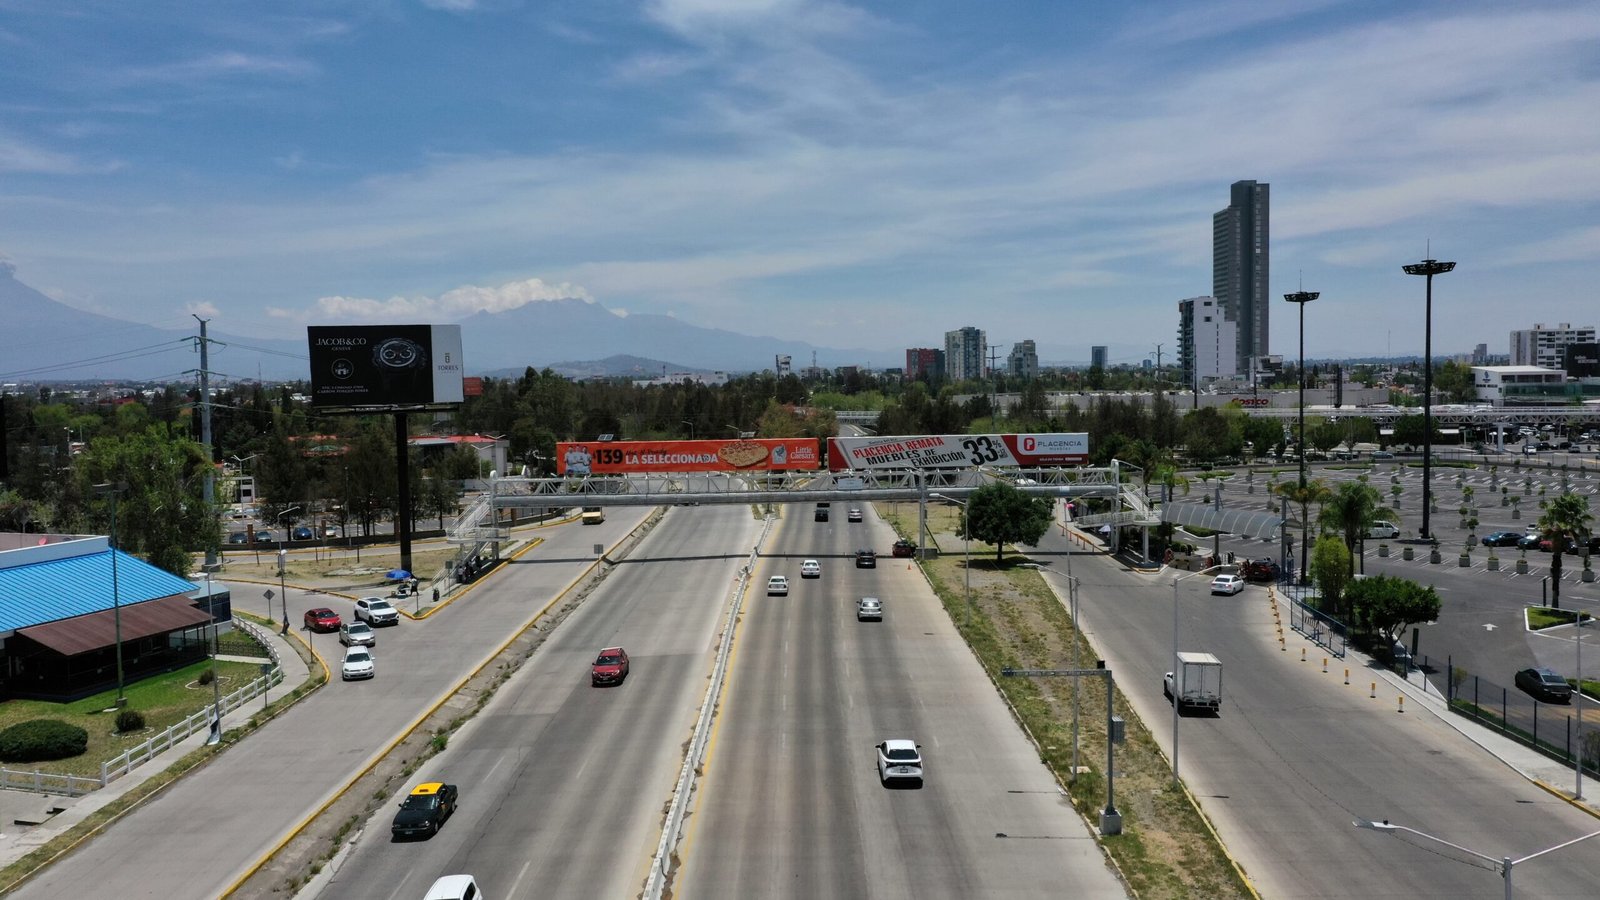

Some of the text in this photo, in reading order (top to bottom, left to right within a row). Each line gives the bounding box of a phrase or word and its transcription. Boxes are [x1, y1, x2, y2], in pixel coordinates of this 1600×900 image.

[315, 337, 367, 346] JACOB&CO
[852, 436, 945, 459] PLACENCIA REMATA
[625, 453, 719, 465] LA SELECCIONADA
[866, 448, 936, 465] MUEBLES DE
[910, 451, 966, 467] EXHIBICIÓN
